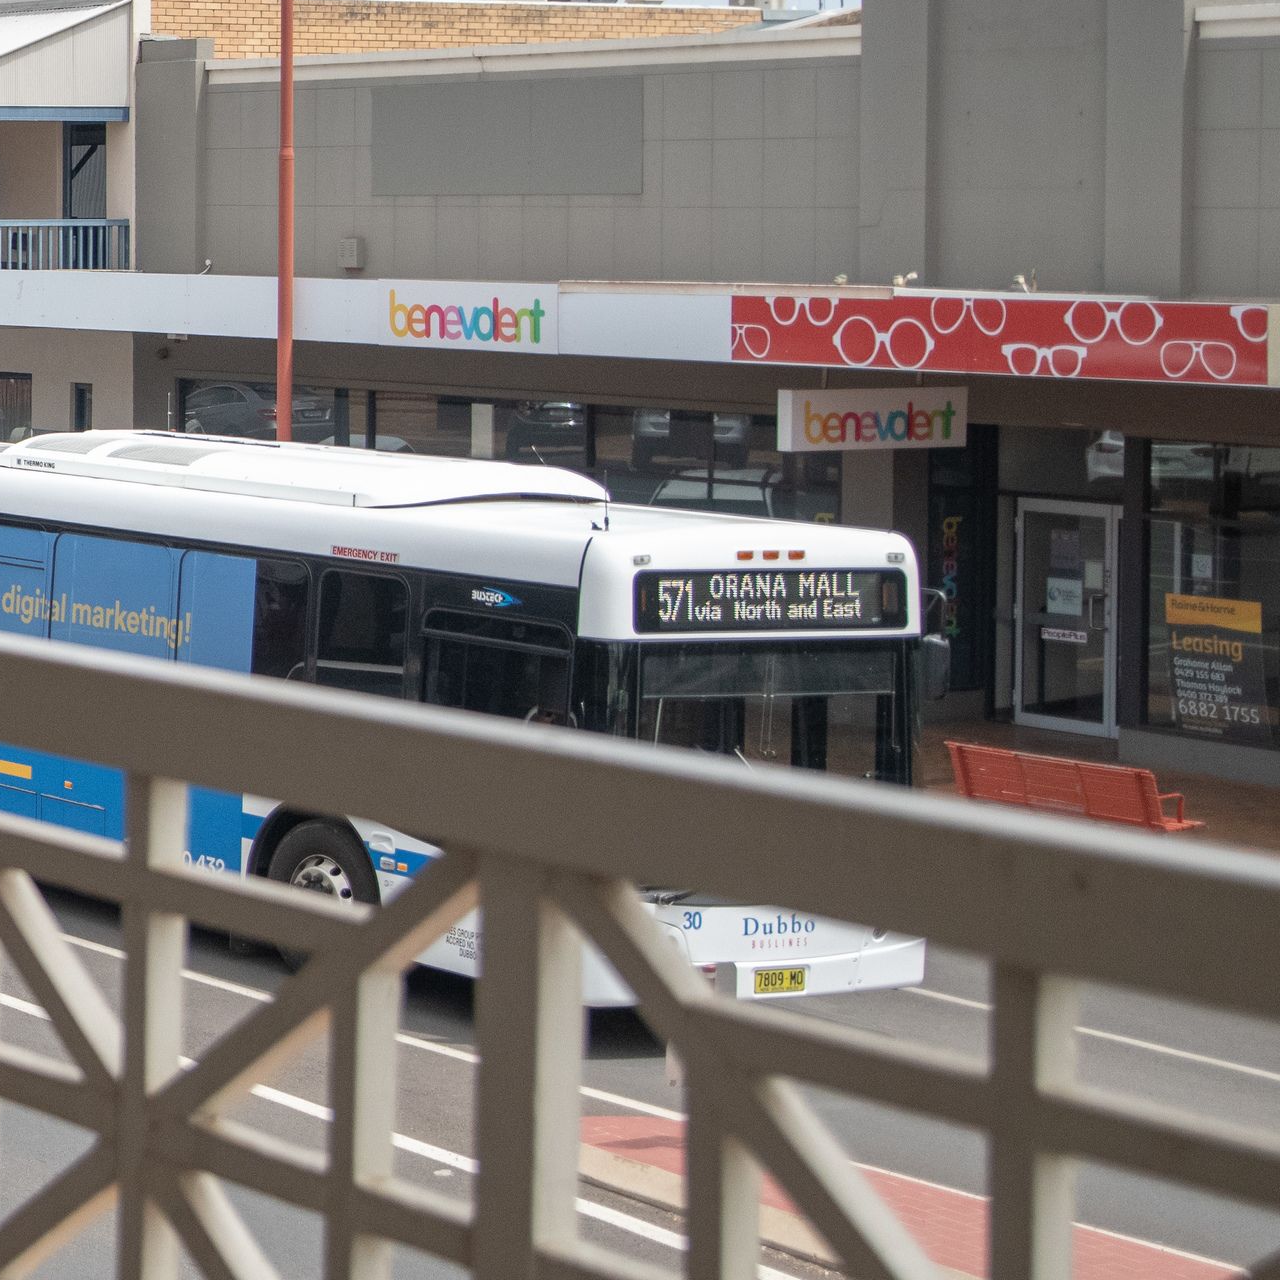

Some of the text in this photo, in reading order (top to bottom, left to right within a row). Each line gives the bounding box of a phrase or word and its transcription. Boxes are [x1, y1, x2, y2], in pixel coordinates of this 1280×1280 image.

[389, 289, 545, 344] benevolent
[804, 400, 956, 444] benevolent
[23, 460, 43, 468] THERMO
[332, 546, 398, 563] EMERGENCY EXIT
[709, 572, 860, 600] ORANA MALL
[658, 578, 693, 622] 571
[694, 597, 862, 621] via North and East
[2, 584, 67, 624] digital
[72, 600, 192, 649] marketing!
[1172, 631, 1243, 662] Leasing
[1178, 699, 1218, 719] 6882
[682, 911, 703, 930] 30
[743, 913, 816, 936] Dubbo
[446, 935, 466, 948] ACCRED
[751, 937, 808, 950] BUSLINES
